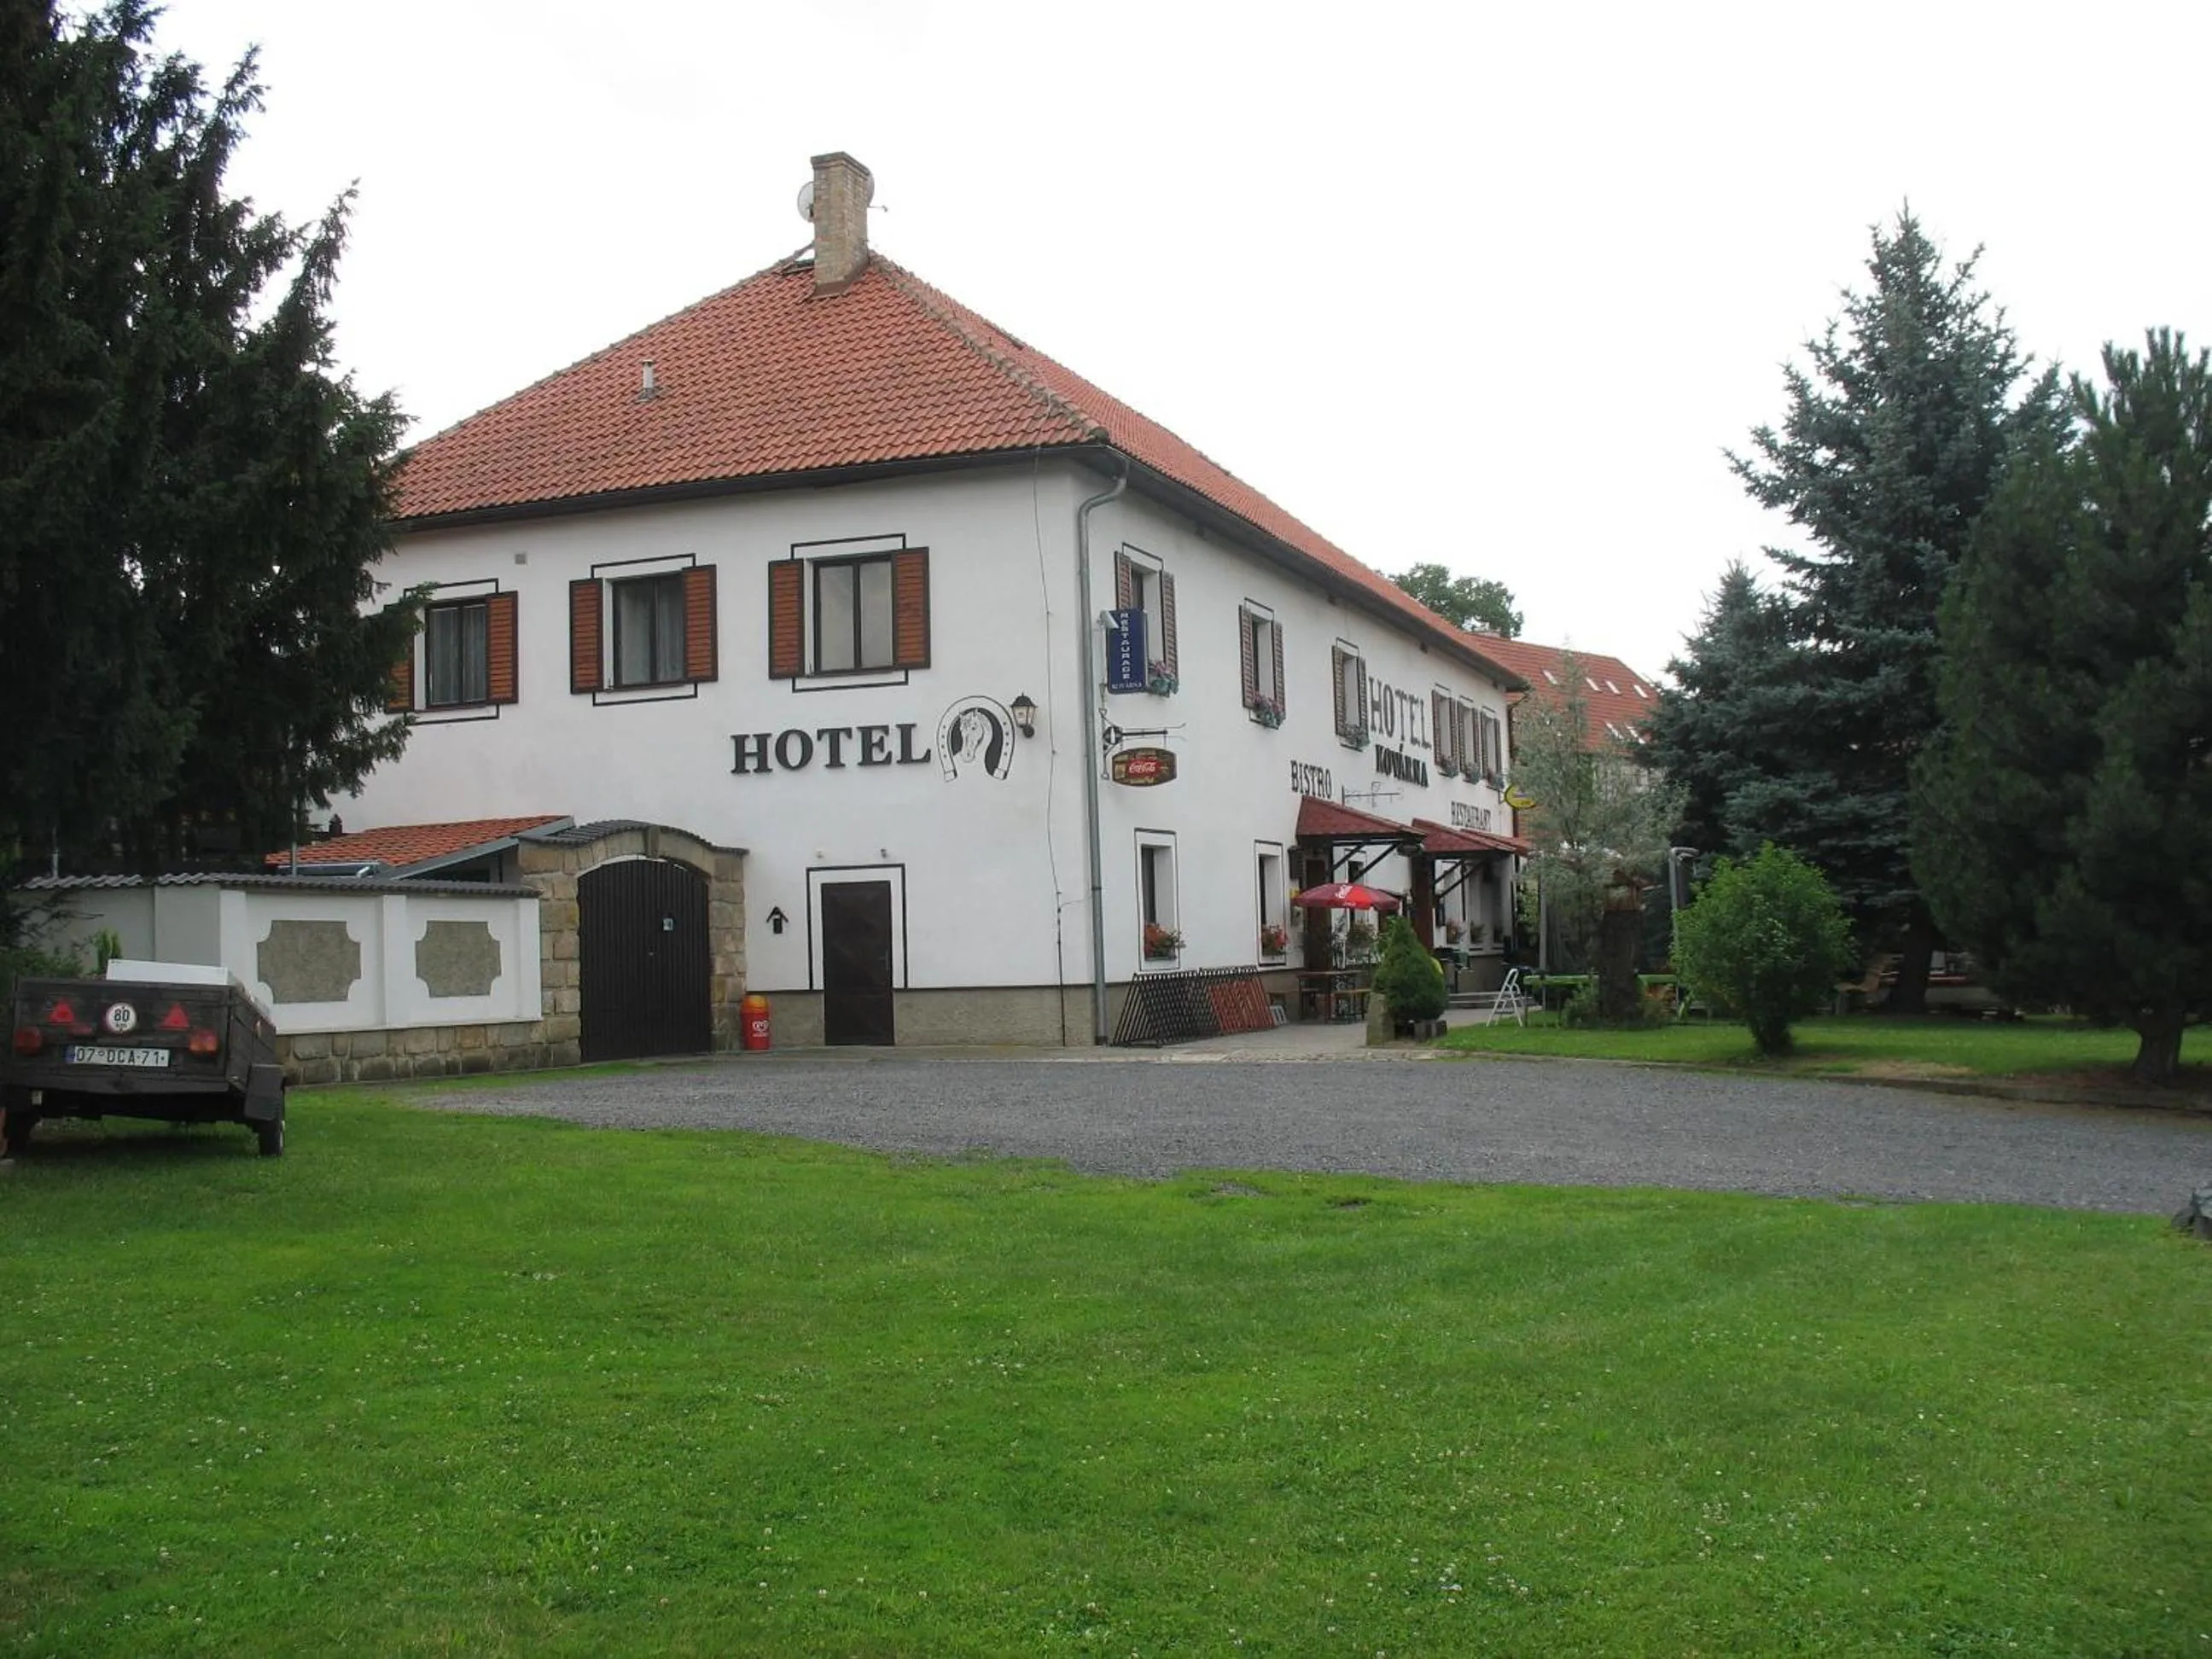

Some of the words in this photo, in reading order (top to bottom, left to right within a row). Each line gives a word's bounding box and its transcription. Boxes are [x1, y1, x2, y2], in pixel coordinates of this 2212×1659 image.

[1368, 676, 1433, 750] HOTEL
[730, 723, 931, 774] HOTEL
[1375, 743, 1429, 788] KOVÁRNA
[1289, 759, 1333, 799] BISTRO
[114, 1009, 131, 1022] 80
